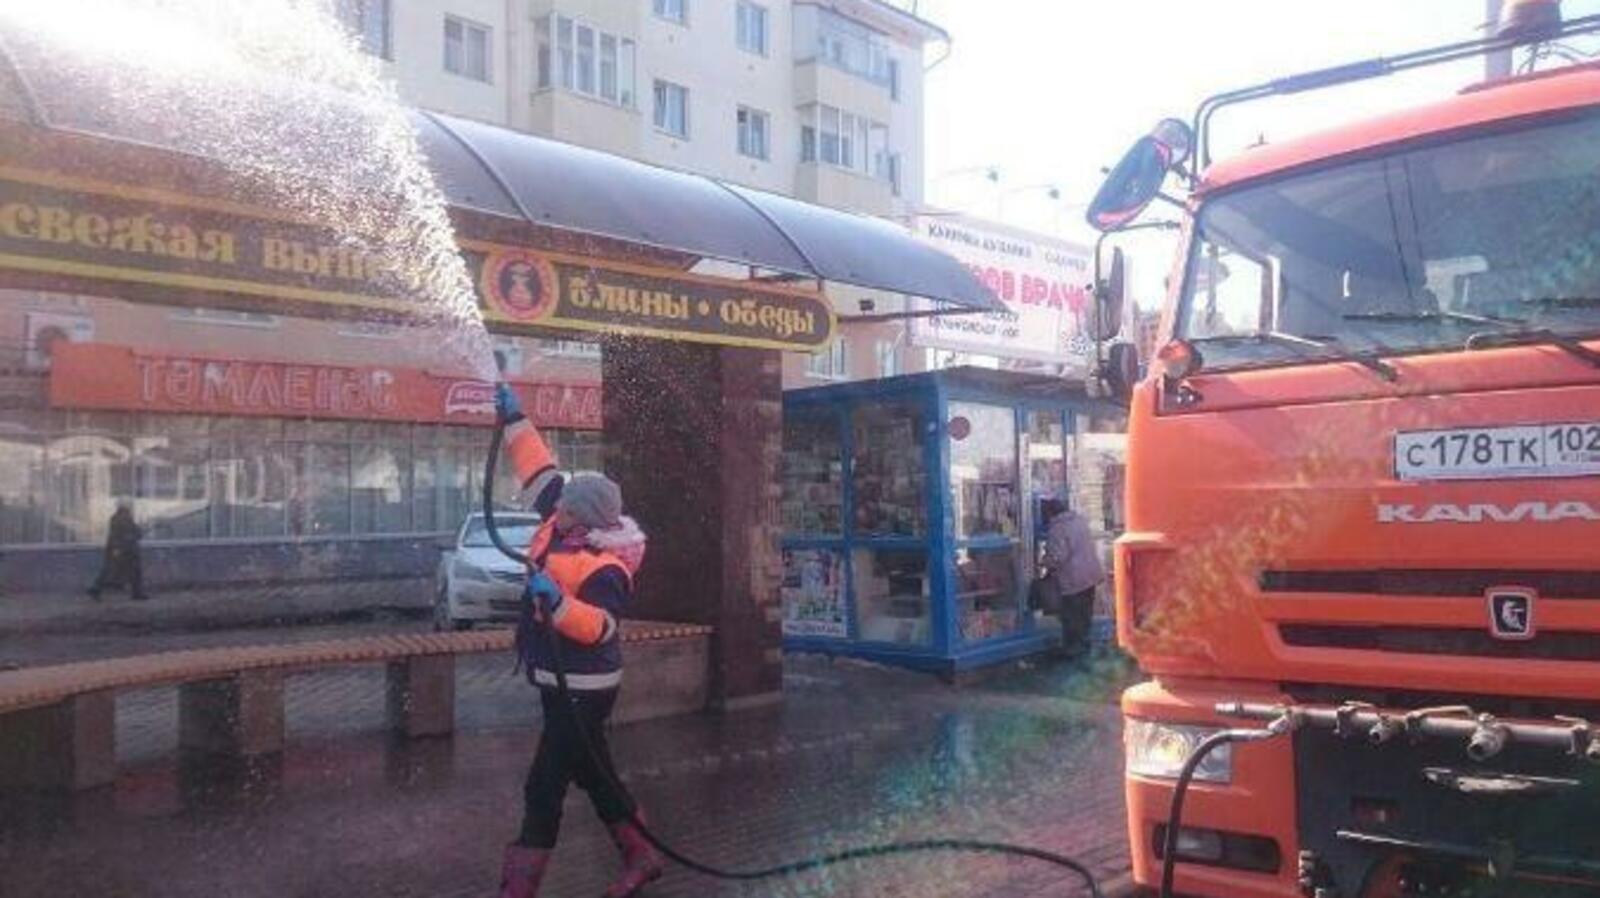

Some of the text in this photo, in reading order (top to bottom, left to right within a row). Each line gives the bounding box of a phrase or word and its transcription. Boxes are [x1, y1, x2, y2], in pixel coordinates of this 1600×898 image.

[568, 276, 689, 319] блины
[1406, 427, 1600, 467] С178ТК 102
